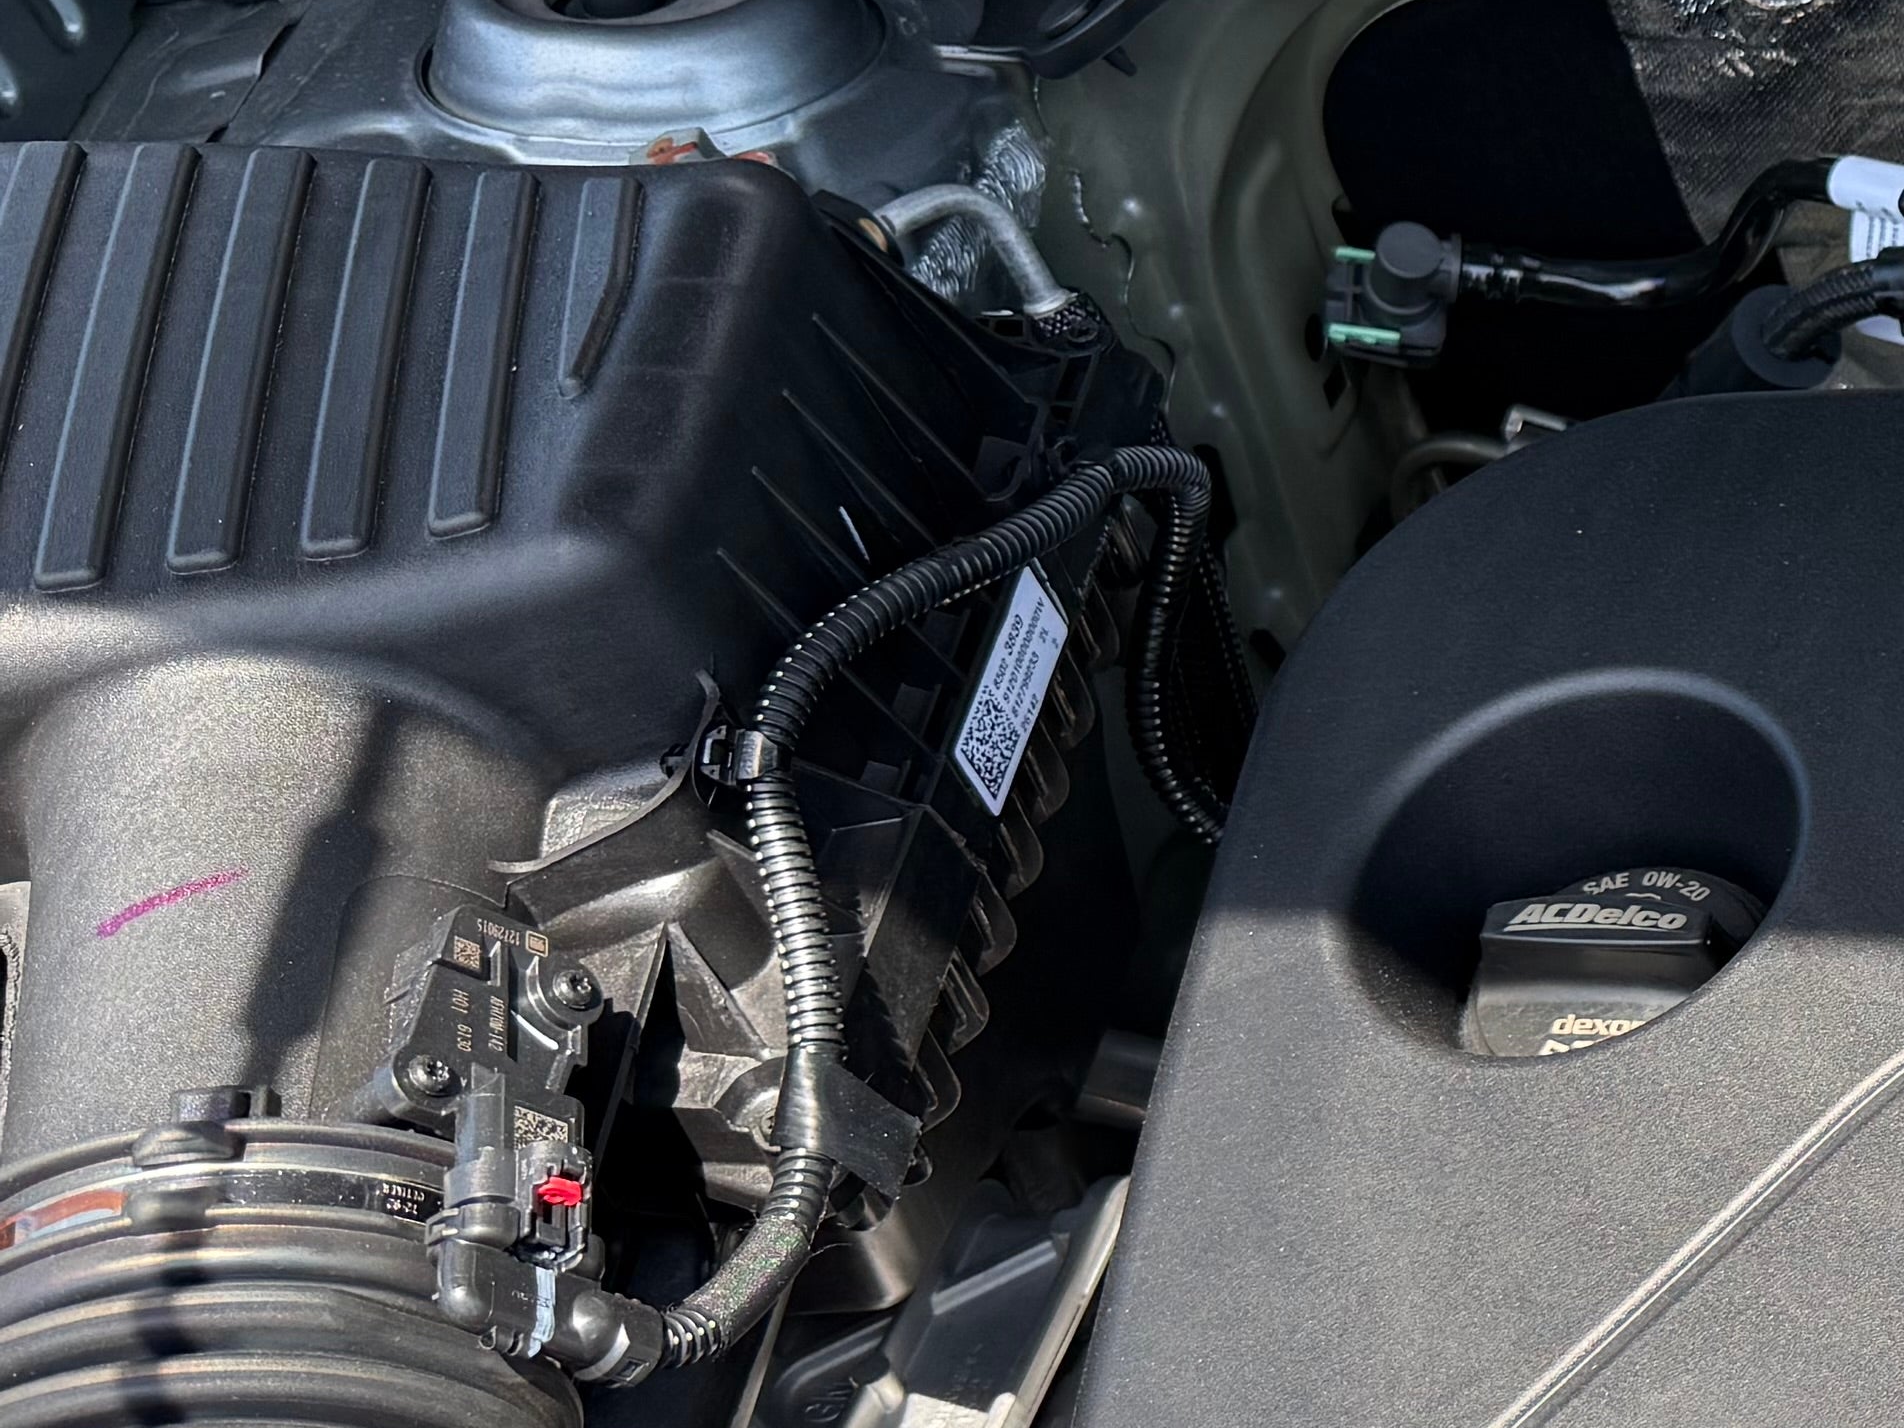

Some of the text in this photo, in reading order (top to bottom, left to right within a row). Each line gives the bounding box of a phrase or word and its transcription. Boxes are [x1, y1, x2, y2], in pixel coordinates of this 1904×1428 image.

[1003, 613, 1024, 656] 3839
[1582, 871, 1711, 902] SAE 0W-20
[1508, 903, 1688, 930] ACDelco
